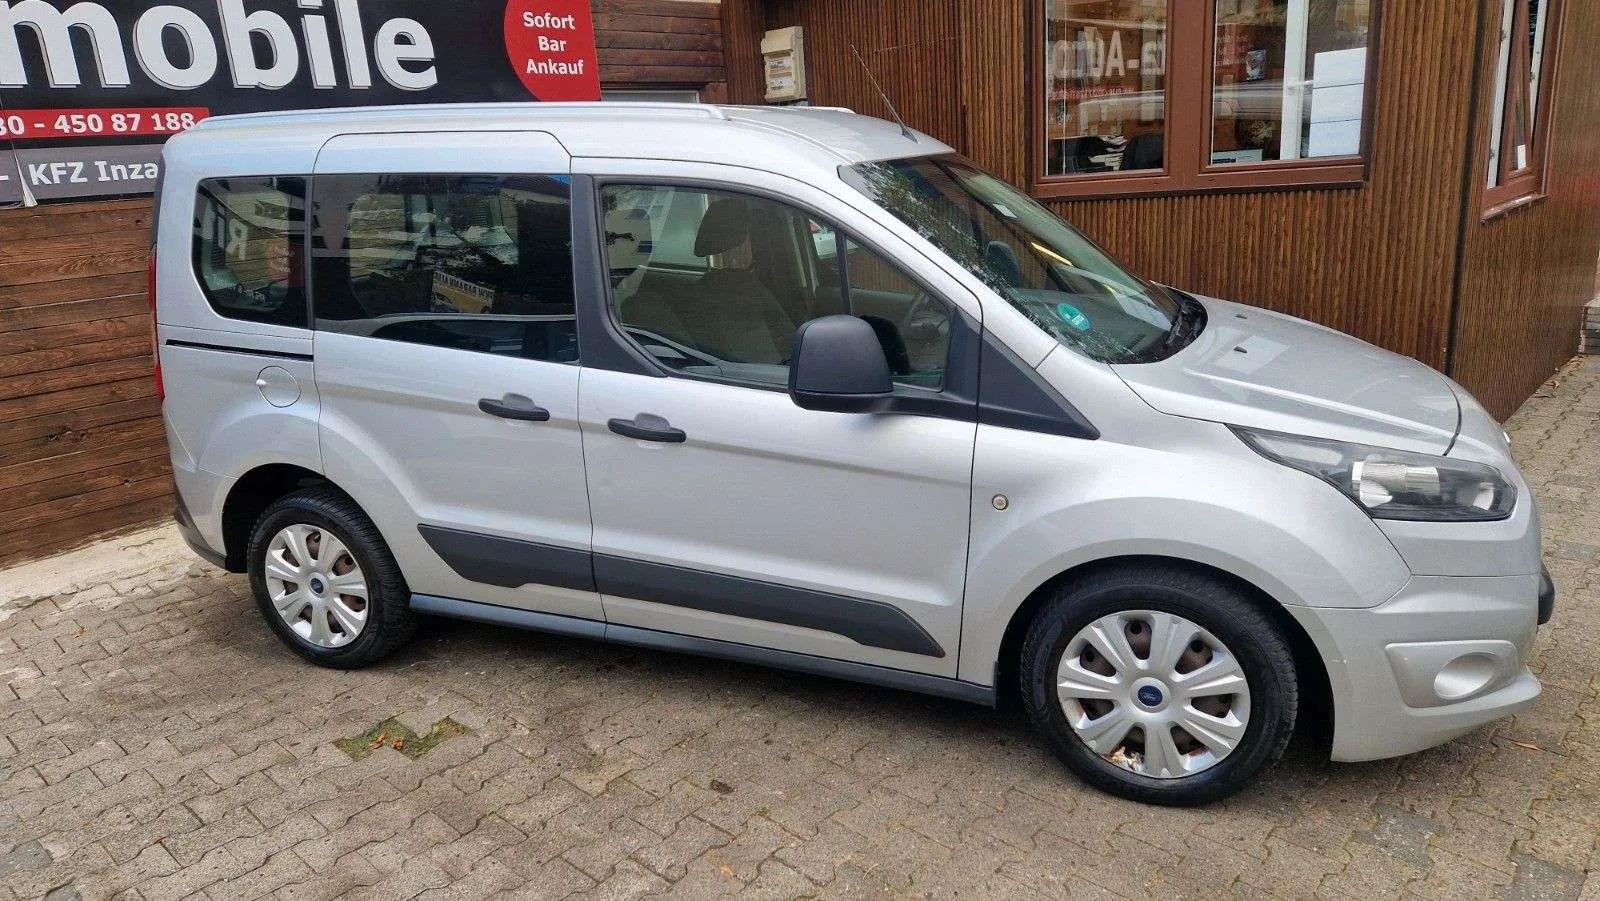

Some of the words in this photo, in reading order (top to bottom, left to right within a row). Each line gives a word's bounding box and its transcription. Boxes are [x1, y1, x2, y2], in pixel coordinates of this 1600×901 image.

[523, 11, 576, 30] Sofort
[0, 0, 438, 91] mobile
[538, 35, 567, 52] Bar
[526, 58, 584, 75] Ankauf
[54, 113, 104, 134] 450
[111, 113, 141, 132] 87
[151, 112, 195, 131] 188
[28, 161, 88, 186] KFZ
[95, 160, 159, 183] Inza
